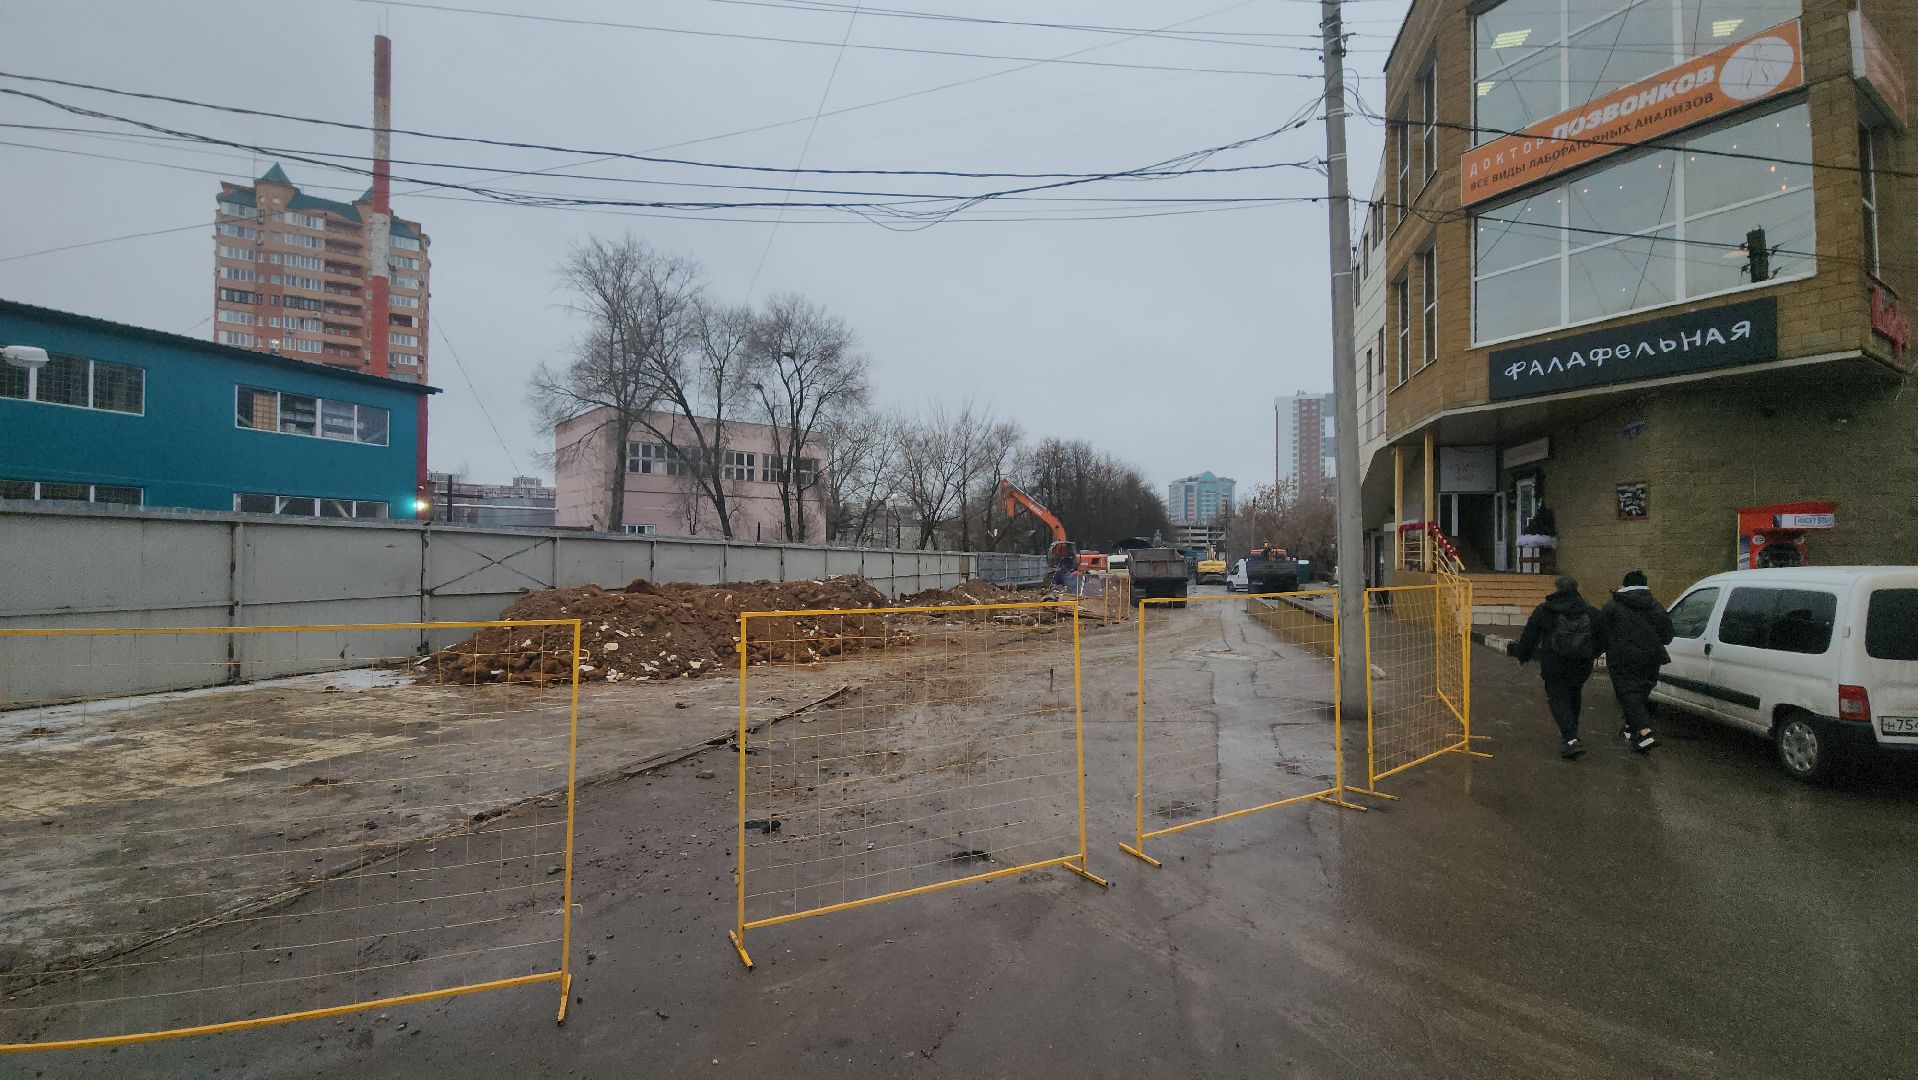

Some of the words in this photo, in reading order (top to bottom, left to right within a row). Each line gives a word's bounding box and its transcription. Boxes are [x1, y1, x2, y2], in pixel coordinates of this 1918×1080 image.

[1470, 138, 1544, 177] ДОКТОР
[1551, 65, 1716, 143] ПОЗВОНКОВ
[1470, 176, 1489, 191] ВСЕ
[1492, 163, 1526, 183] ВИДЫ
[1529, 124, 1632, 169] ЛАБОРАТОРНЫХ
[1635, 92, 1714, 129] АНАЛИЗОВ
